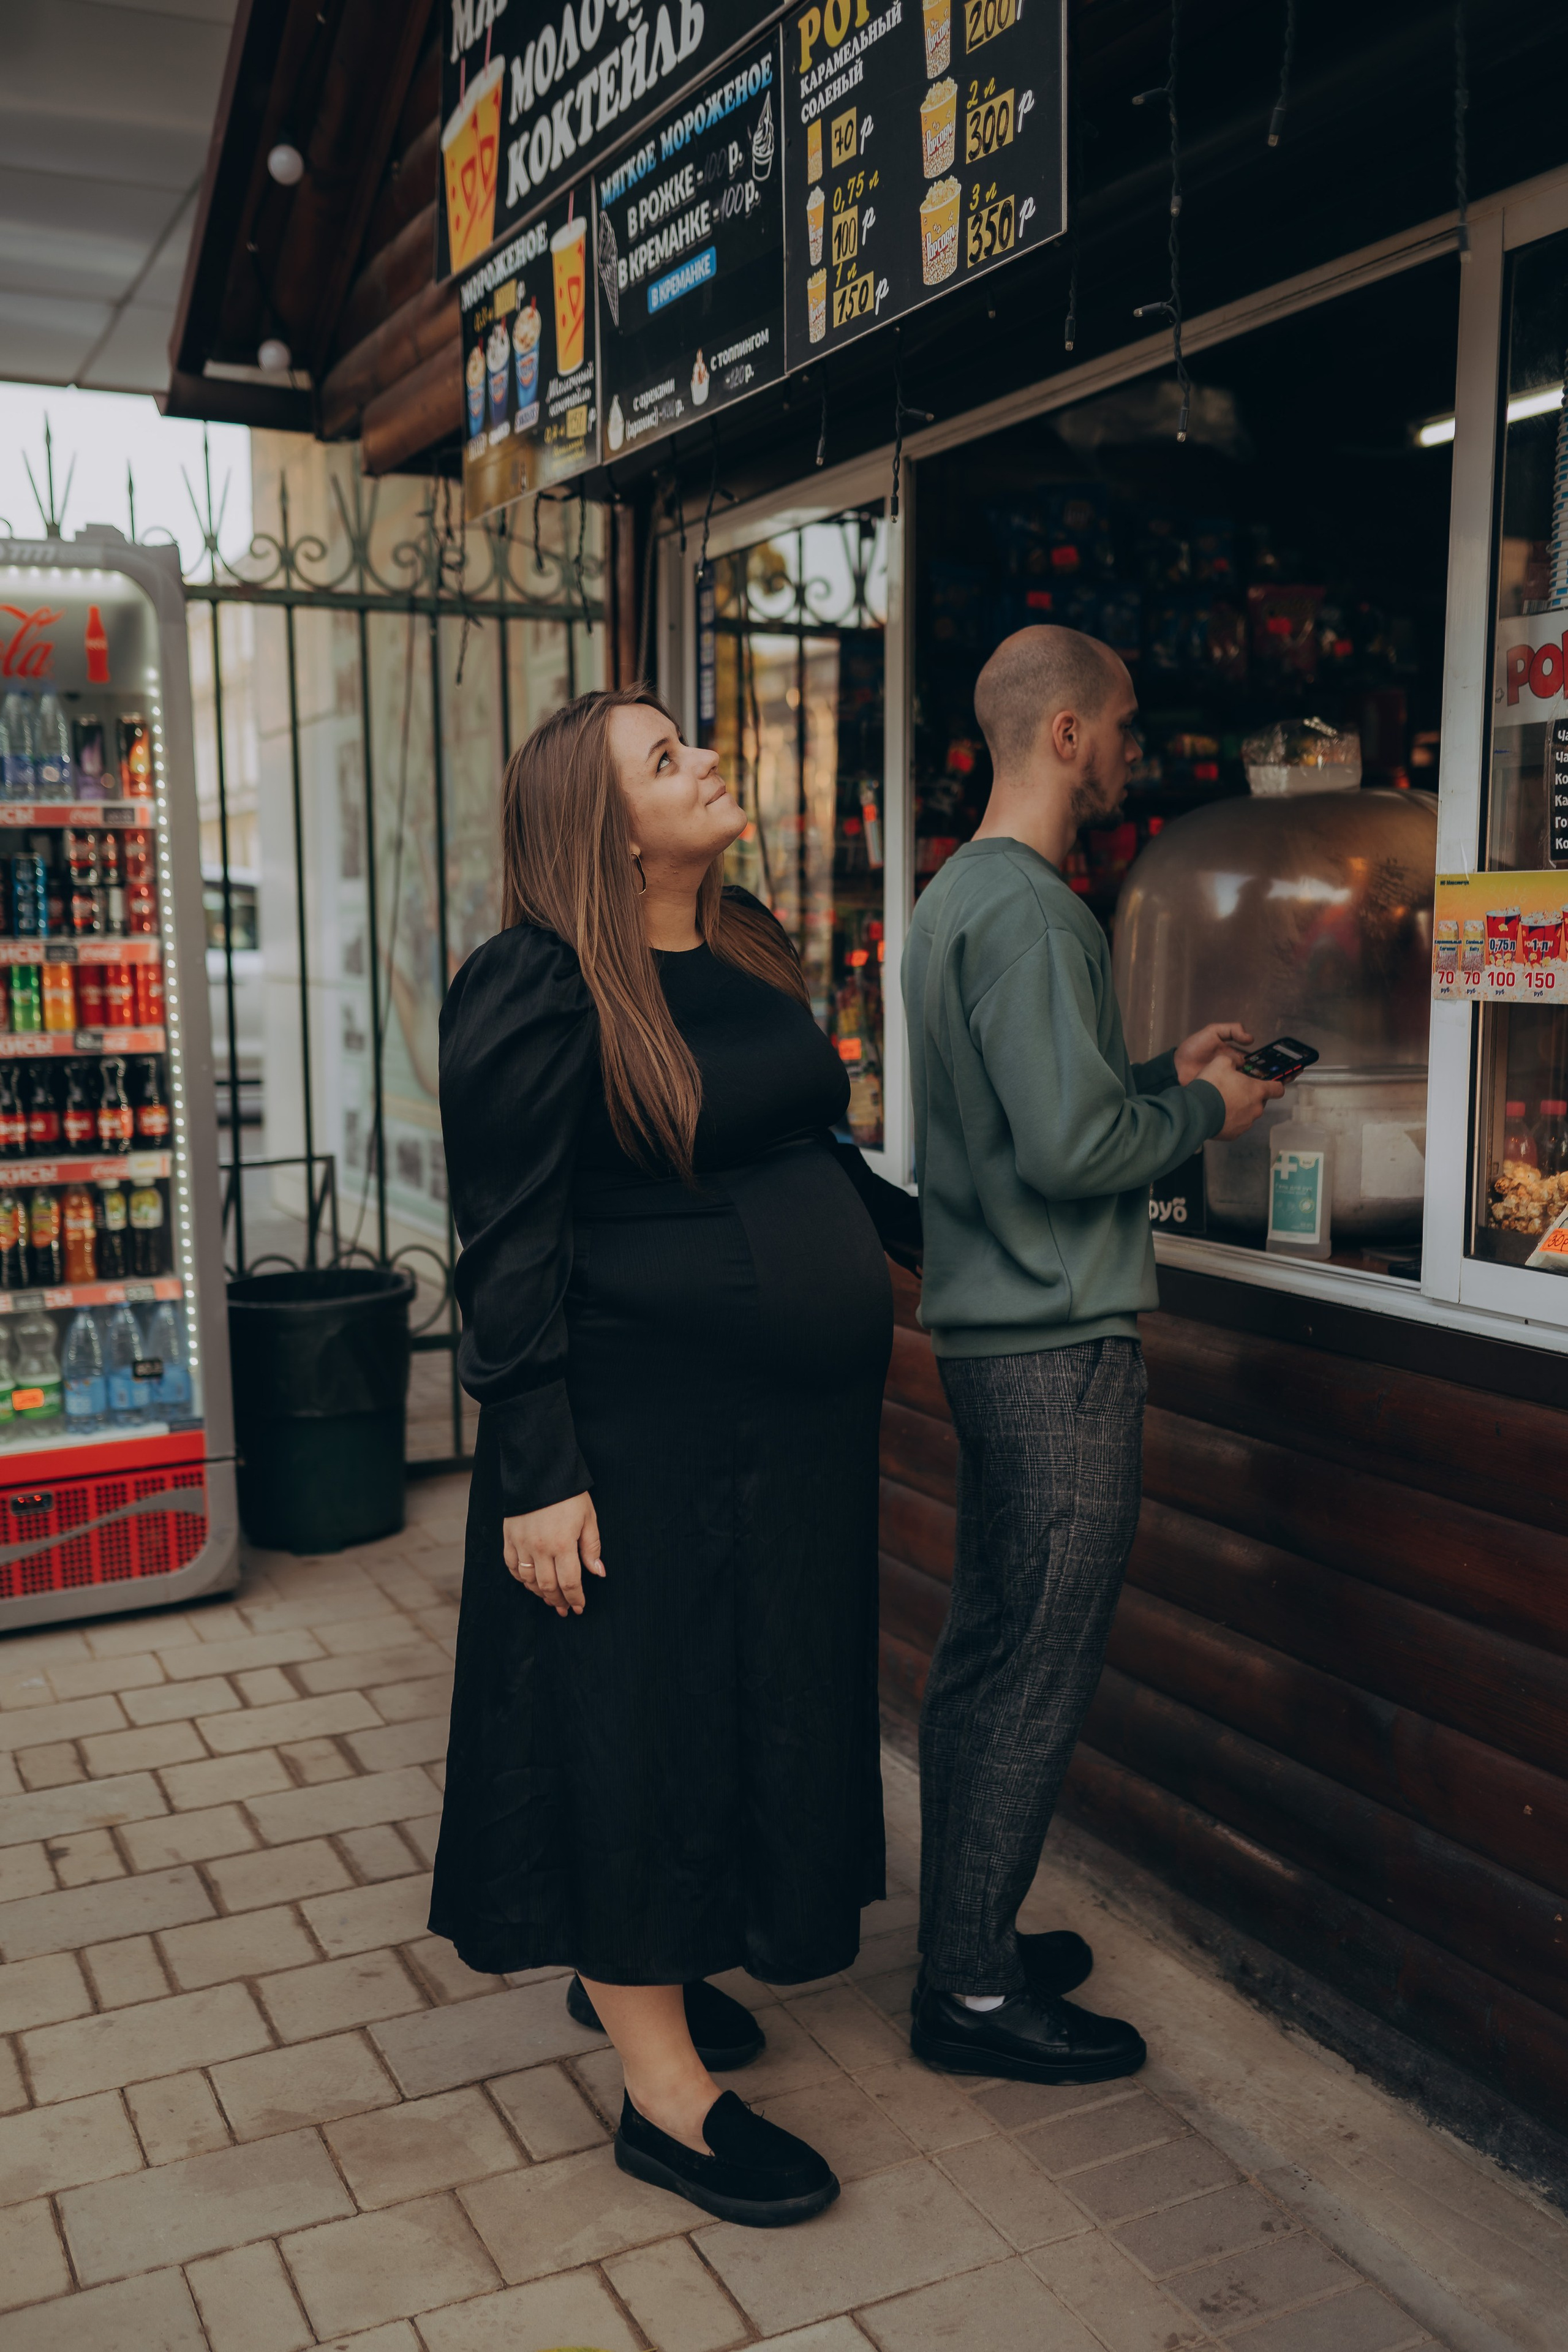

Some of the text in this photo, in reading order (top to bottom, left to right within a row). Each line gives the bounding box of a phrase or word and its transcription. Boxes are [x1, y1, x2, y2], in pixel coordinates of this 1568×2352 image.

[800, 0, 902, 99] КАРАМЕЛЬНЫЙ
[505, 0, 705, 209] КОКТЕЙЛЬ
[801, 56, 864, 124] СОЛЕНЫЙ
[966, 80, 978, 110] 2
[600, 51, 773, 208] МЯГКОЕ МОРОЖЕНОЕ
[835, 119, 854, 156] 70
[968, 100, 1009, 160] 300
[627, 205, 638, 239] В
[639, 162, 696, 231] РОЖКЕ
[832, 170, 865, 213] 0,75
[969, 183, 980, 211] 3
[618, 257, 628, 290] В
[628, 200, 711, 283] КРЕМАНКЕ
[834, 217, 856, 260] 100
[968, 200, 1013, 264] 350
[651, 254, 711, 308] В КРЕМАНКЕ
[836, 262, 843, 288] 1
[838, 279, 869, 323] 150
[1507, 629, 1568, 707] PO
[1532, 939, 1538, 951] 1
[1438, 971, 1454, 984] 70
[1464, 971, 1480, 985] 70
[1487, 971, 1515, 987] 100
[1525, 973, 1555, 989] 150
